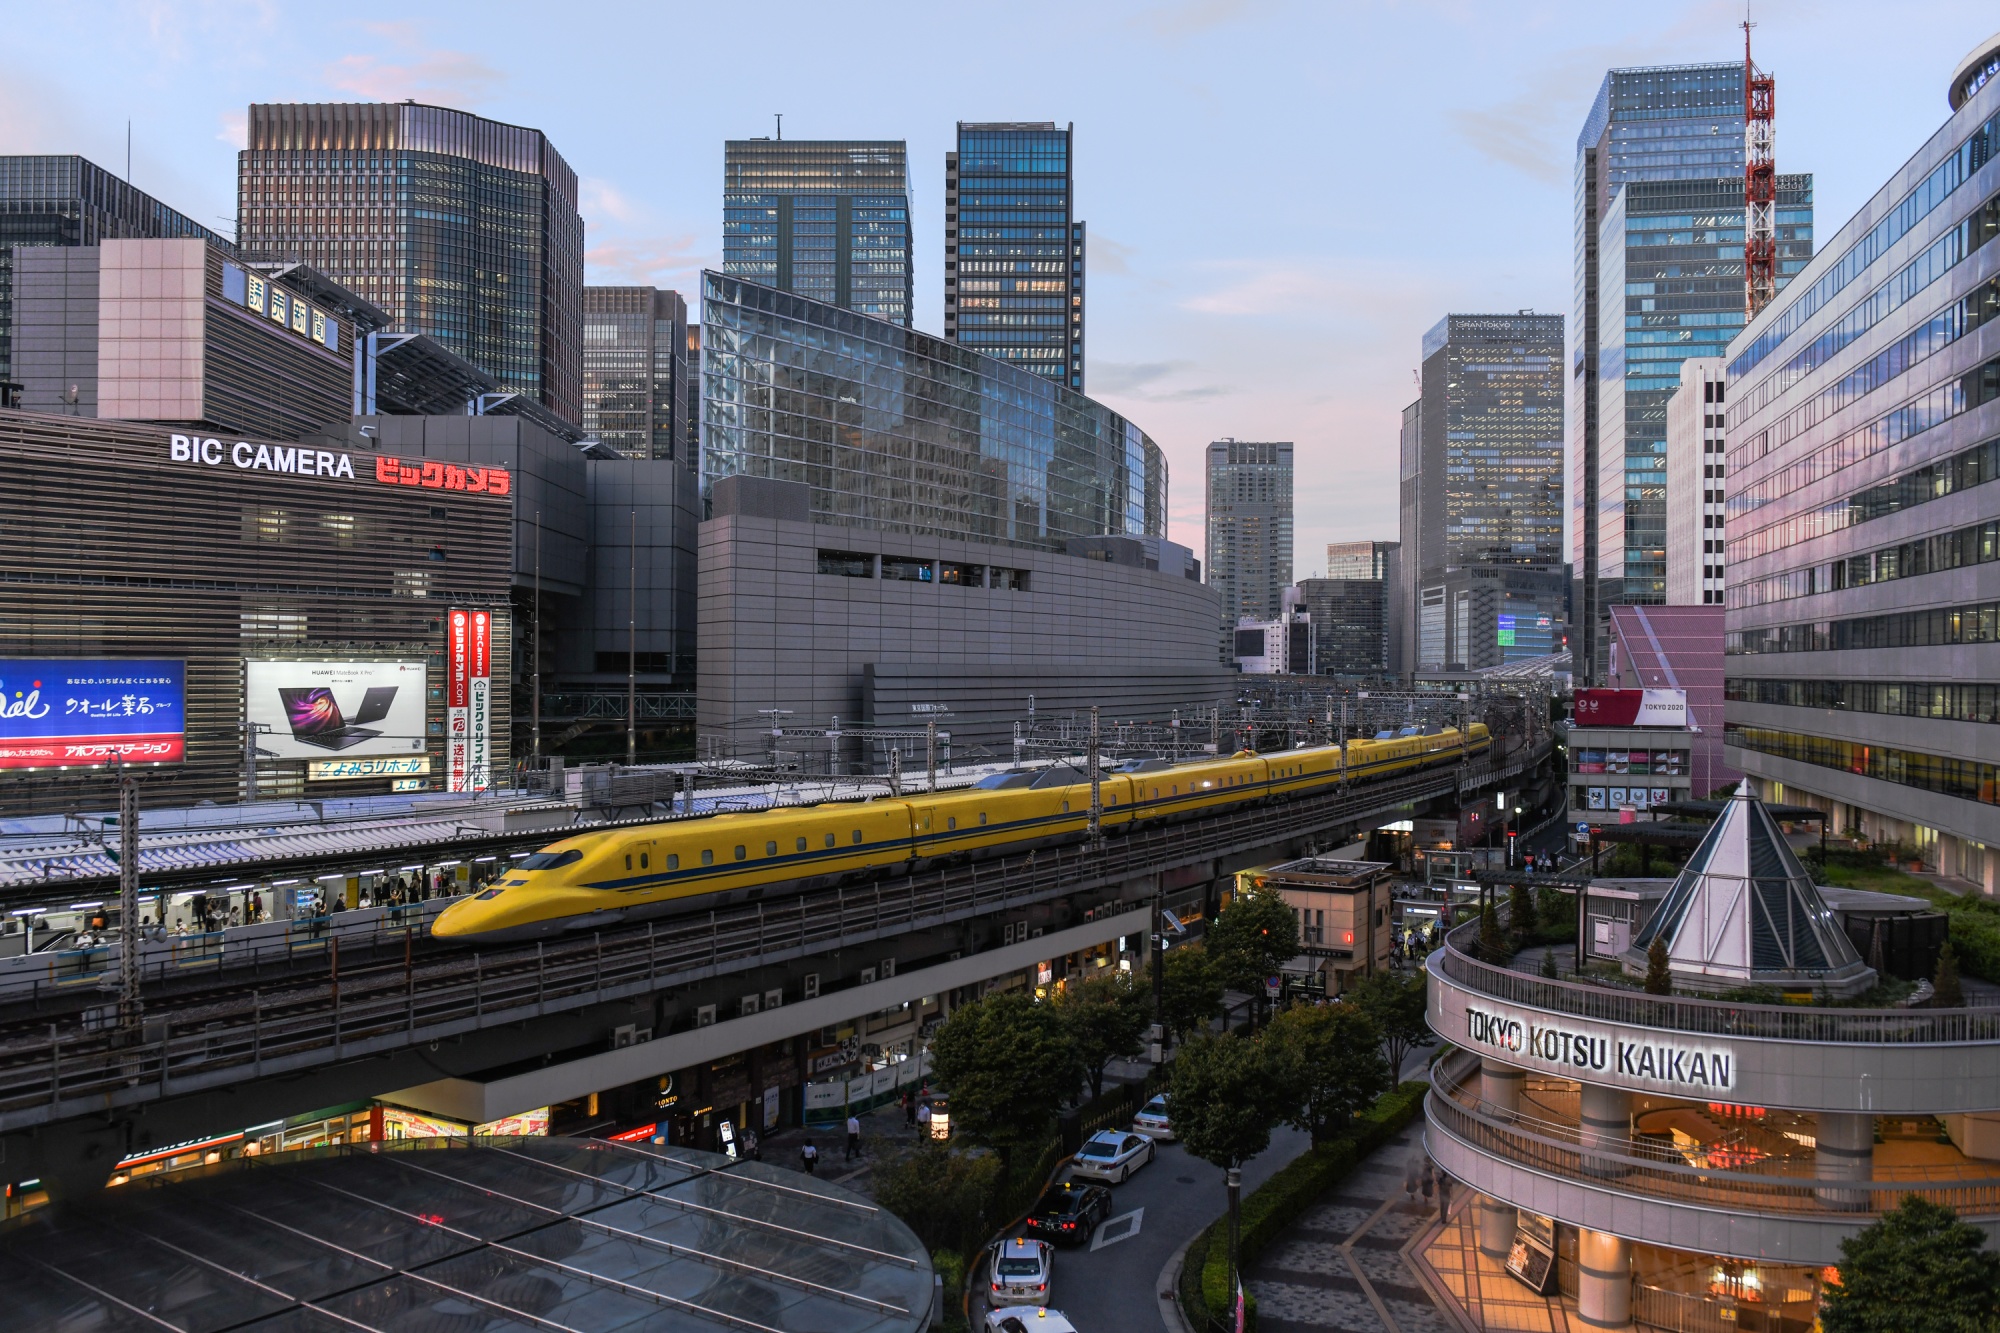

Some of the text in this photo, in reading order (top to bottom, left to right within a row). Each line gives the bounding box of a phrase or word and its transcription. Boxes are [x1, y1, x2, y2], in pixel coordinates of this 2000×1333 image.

[249, 277, 325, 340] 読売新聞
[171, 434, 355, 479] BIC CAMERA
[376, 456, 511, 495] ビックカメラ
[476, 625, 485, 677] BicCamera
[65, 694, 155, 717] クオール薬局
[333, 758, 422, 776] よみうりホール
[453, 744, 465, 792] 送料無料
[1466, 1008, 1731, 1088] TOKYO KOTSU KAIKAN
